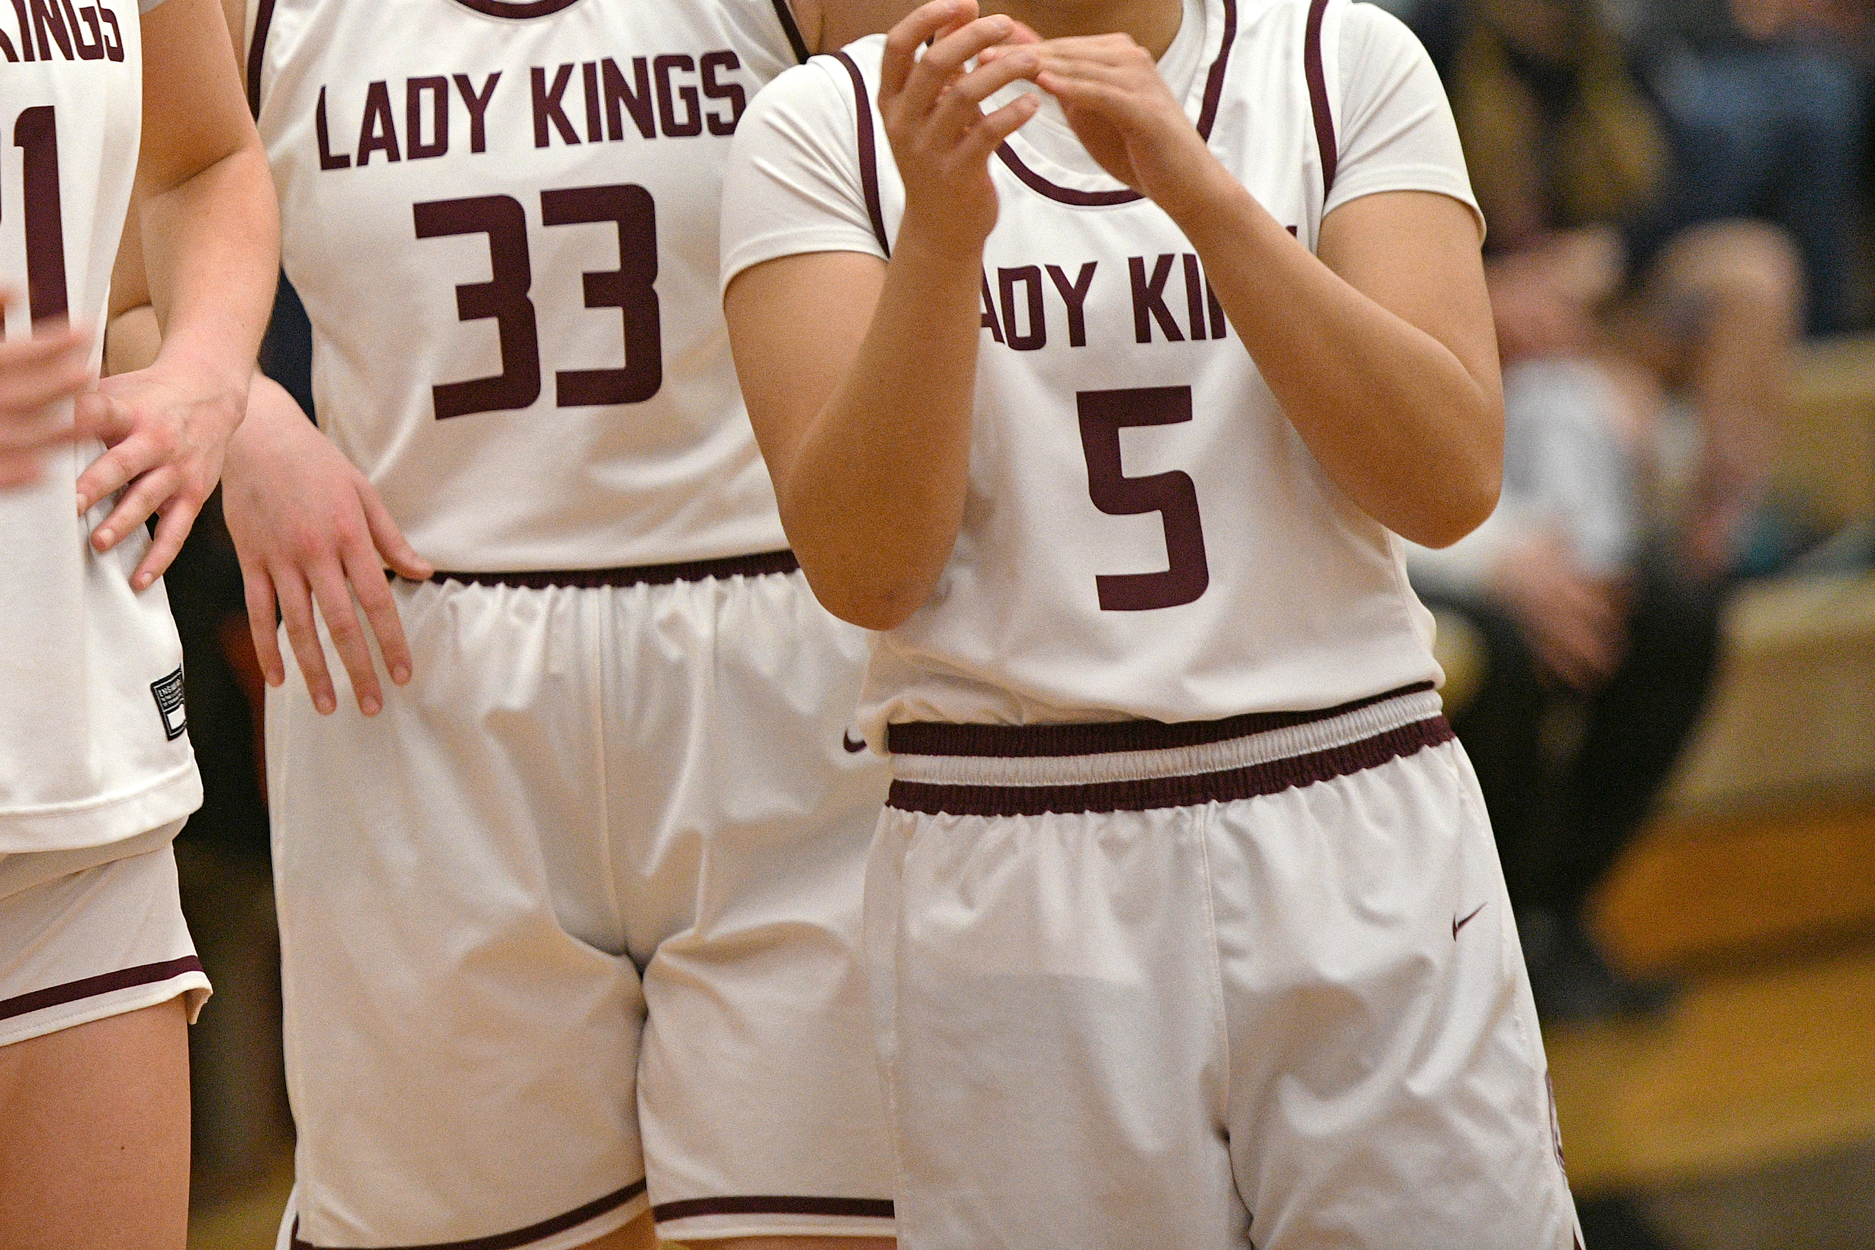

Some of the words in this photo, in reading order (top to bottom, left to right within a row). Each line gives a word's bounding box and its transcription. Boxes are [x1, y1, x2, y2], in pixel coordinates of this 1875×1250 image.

[316, 70, 501, 171] LADY
[530, 49, 746, 149] KINGS
[412, 183, 664, 421] 33
[1076, 385, 1209, 611] 5
